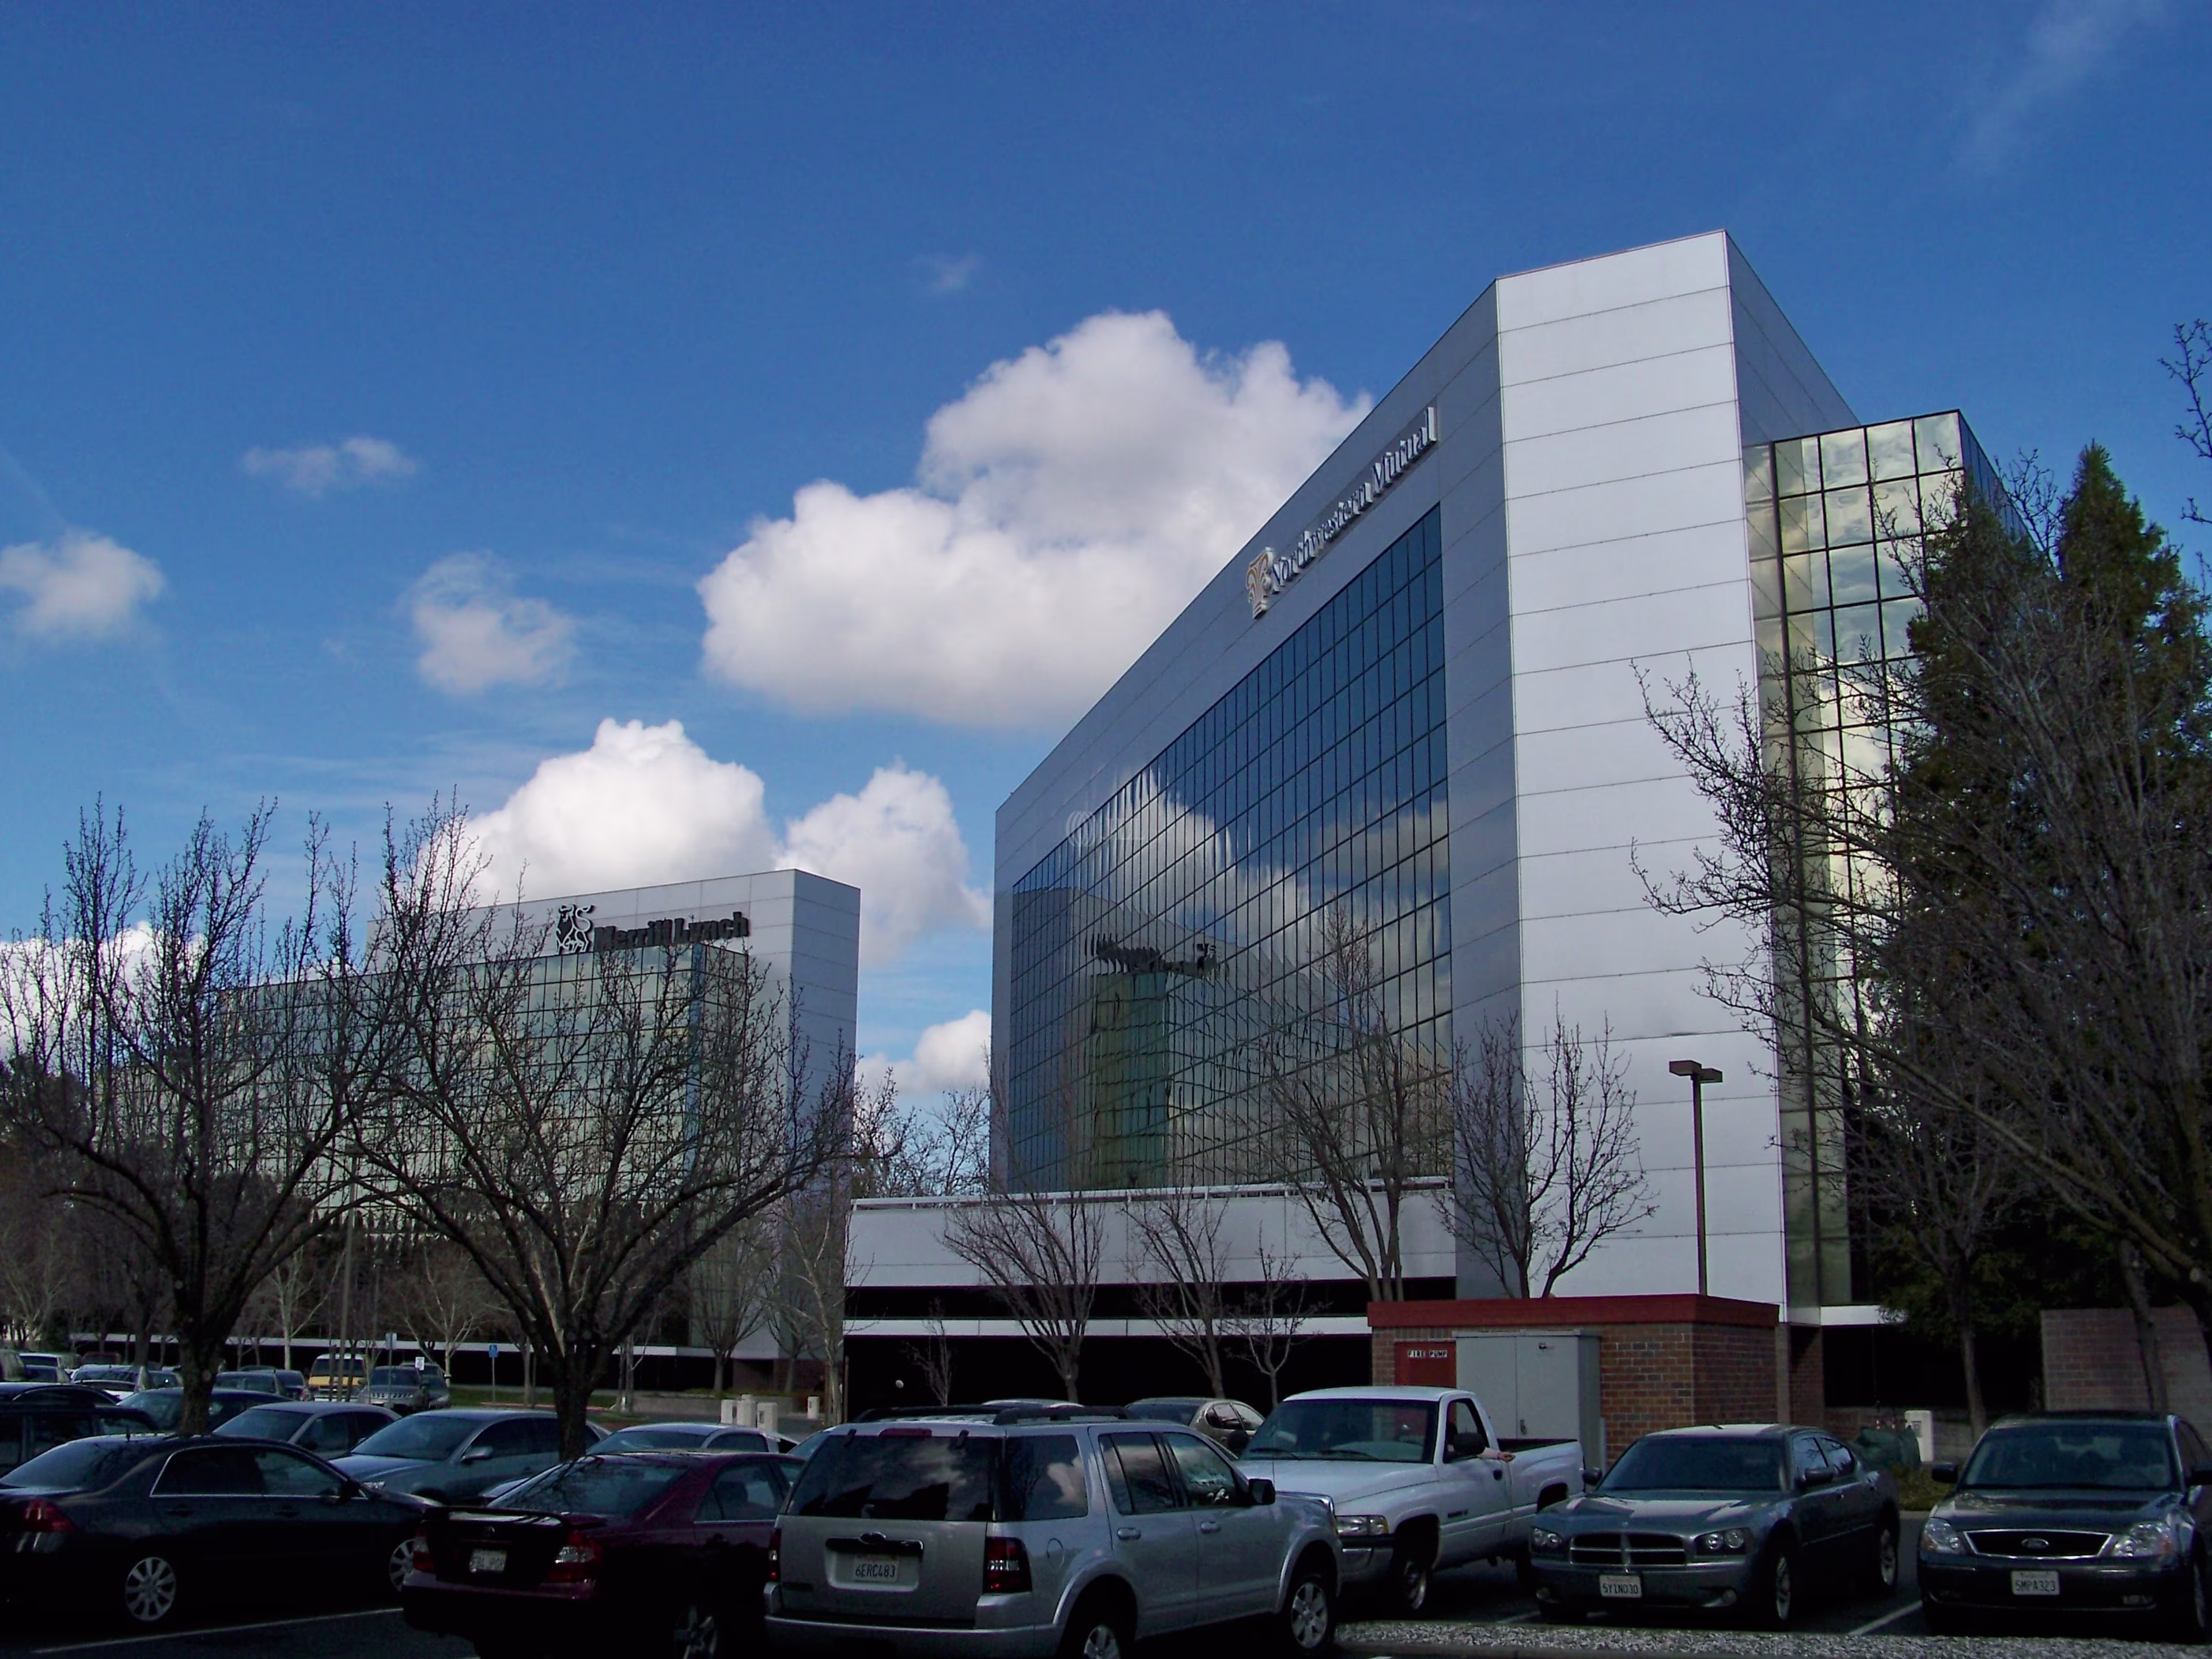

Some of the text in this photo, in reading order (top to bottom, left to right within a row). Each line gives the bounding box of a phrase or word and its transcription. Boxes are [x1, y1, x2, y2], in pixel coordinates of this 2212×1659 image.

[1271, 407, 1437, 594] Northwestern Mutual
[594, 911, 750, 950] Merrill Lynch
[855, 1563, 896, 1578] 6ERC483
